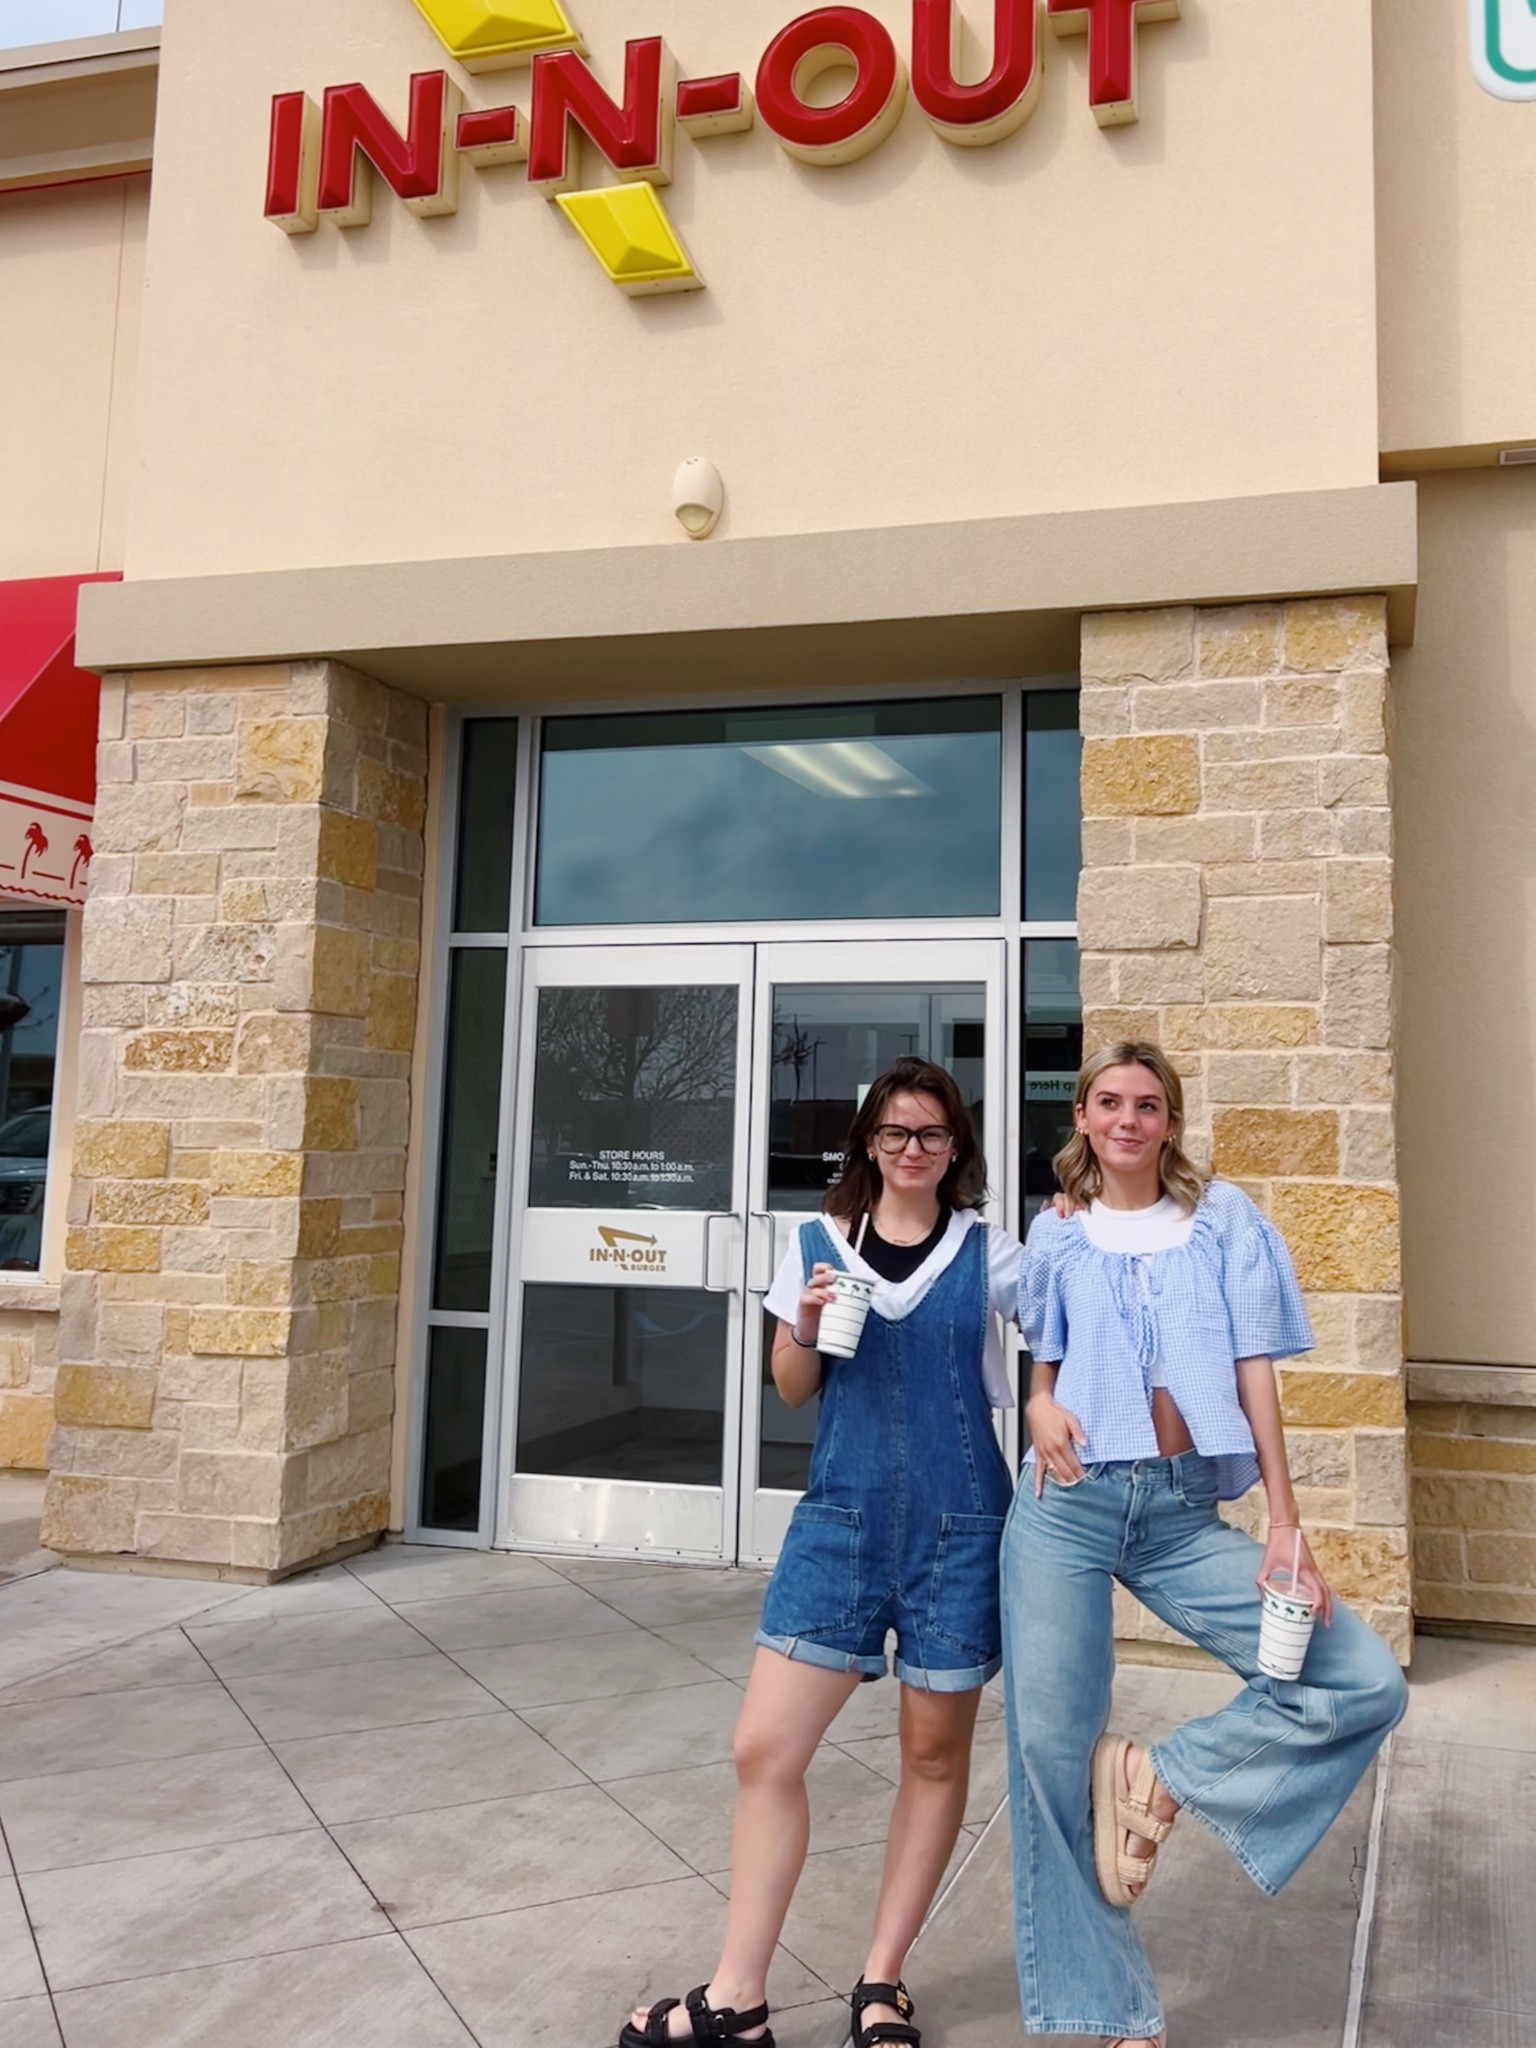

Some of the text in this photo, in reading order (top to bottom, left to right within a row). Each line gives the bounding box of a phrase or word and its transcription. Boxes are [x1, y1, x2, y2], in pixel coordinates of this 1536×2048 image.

[264, 0, 1178, 222] IN-N-OUT
[599, 1150, 665, 1160] STORE HOURS
[650, 1162, 660, 1171] to
[661, 1162, 676, 1171] 1:00
[584, 1171, 591, 1181] &
[651, 1173, 660, 1182] to
[631, 1264, 667, 1272] BURGER
